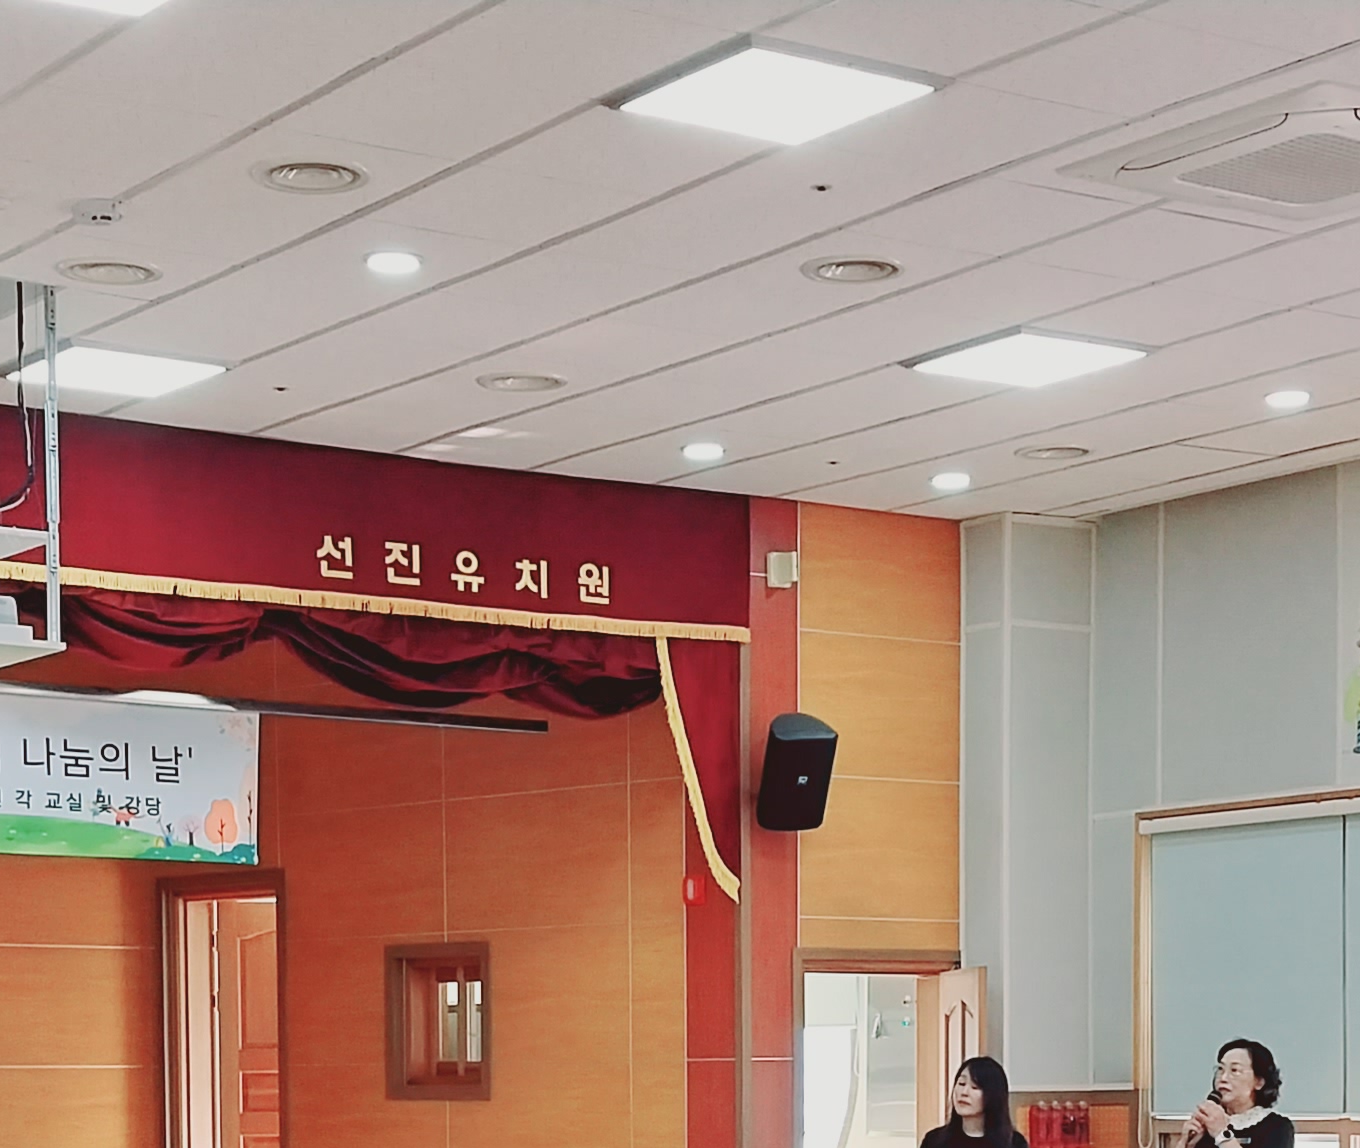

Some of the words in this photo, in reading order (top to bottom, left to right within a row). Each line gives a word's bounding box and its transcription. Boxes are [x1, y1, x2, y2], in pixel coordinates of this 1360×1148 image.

[315, 534, 612, 605] 선진유치원
[22, 736, 130, 781] 나눔의
[151, 745, 193, 784] 날'
[15, 789, 33, 809] 각
[44, 792, 83, 812] 교실
[96, 793, 113, 814] 및
[119, 795, 162, 817] 강당
